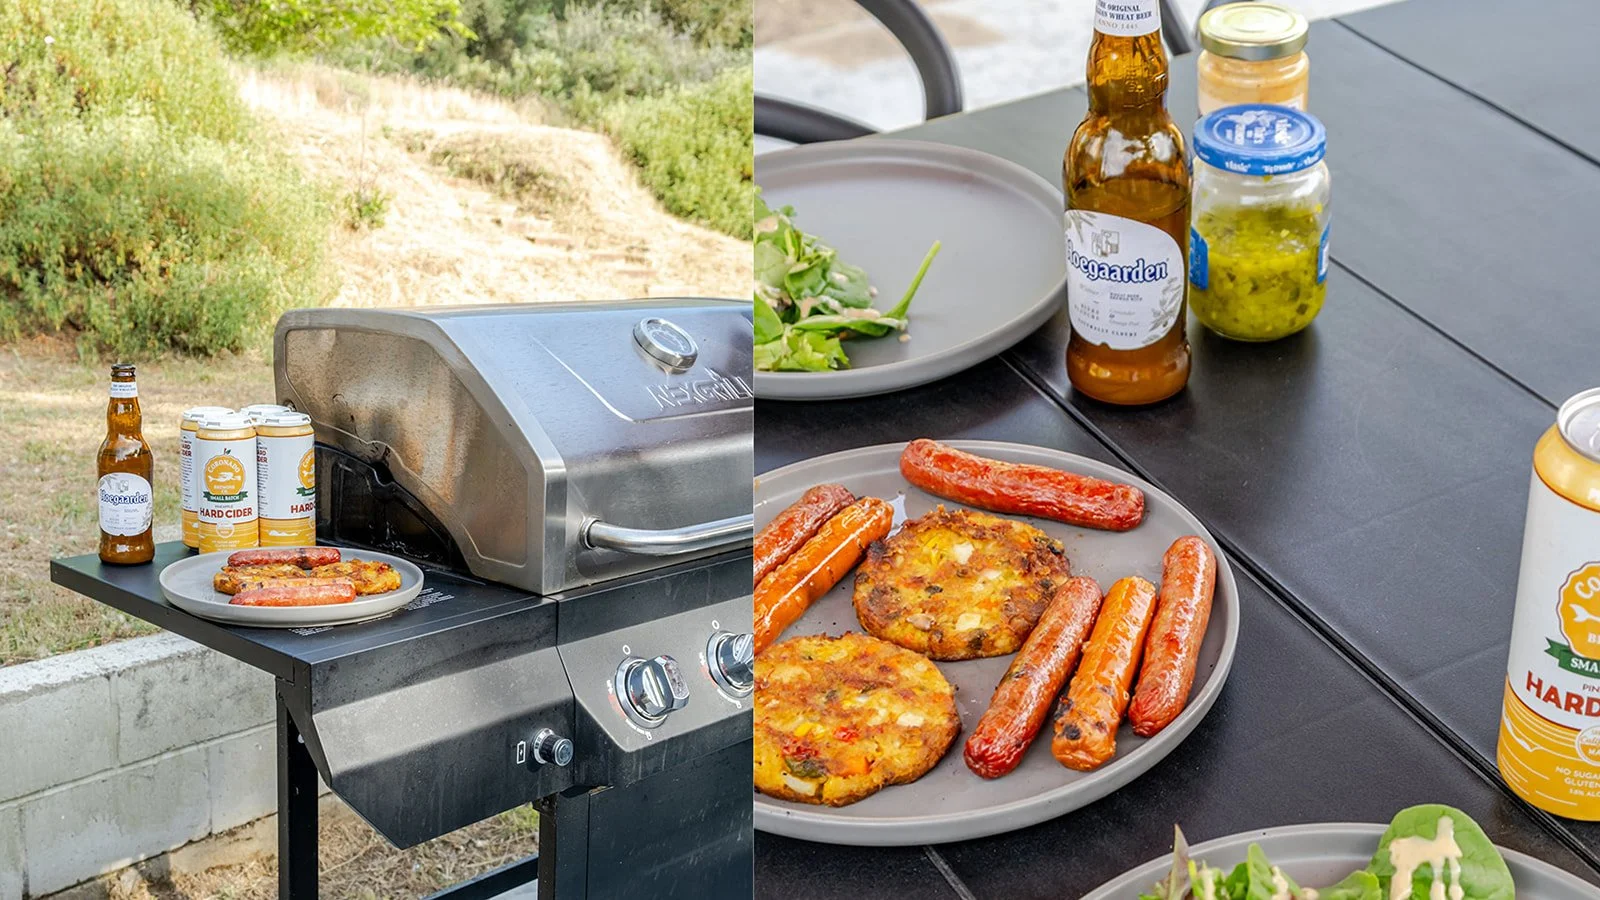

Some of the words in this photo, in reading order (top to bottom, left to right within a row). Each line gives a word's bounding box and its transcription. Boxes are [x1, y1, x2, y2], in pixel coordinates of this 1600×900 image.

[1108, 4, 1141, 12] ORIGINAL
[1109, 11, 1134, 20] WHEAT
[1136, 11, 1152, 20] BEER
[208, 459, 241, 473] CORONADO
[200, 507, 224, 518] HARD
[225, 507, 253, 518] CIDER
[290, 502, 313, 513] HARD
[1526, 670, 1600, 717] HARD
[1555, 766, 1571, 776] NO
[1573, 770, 1600, 779] SUGA
